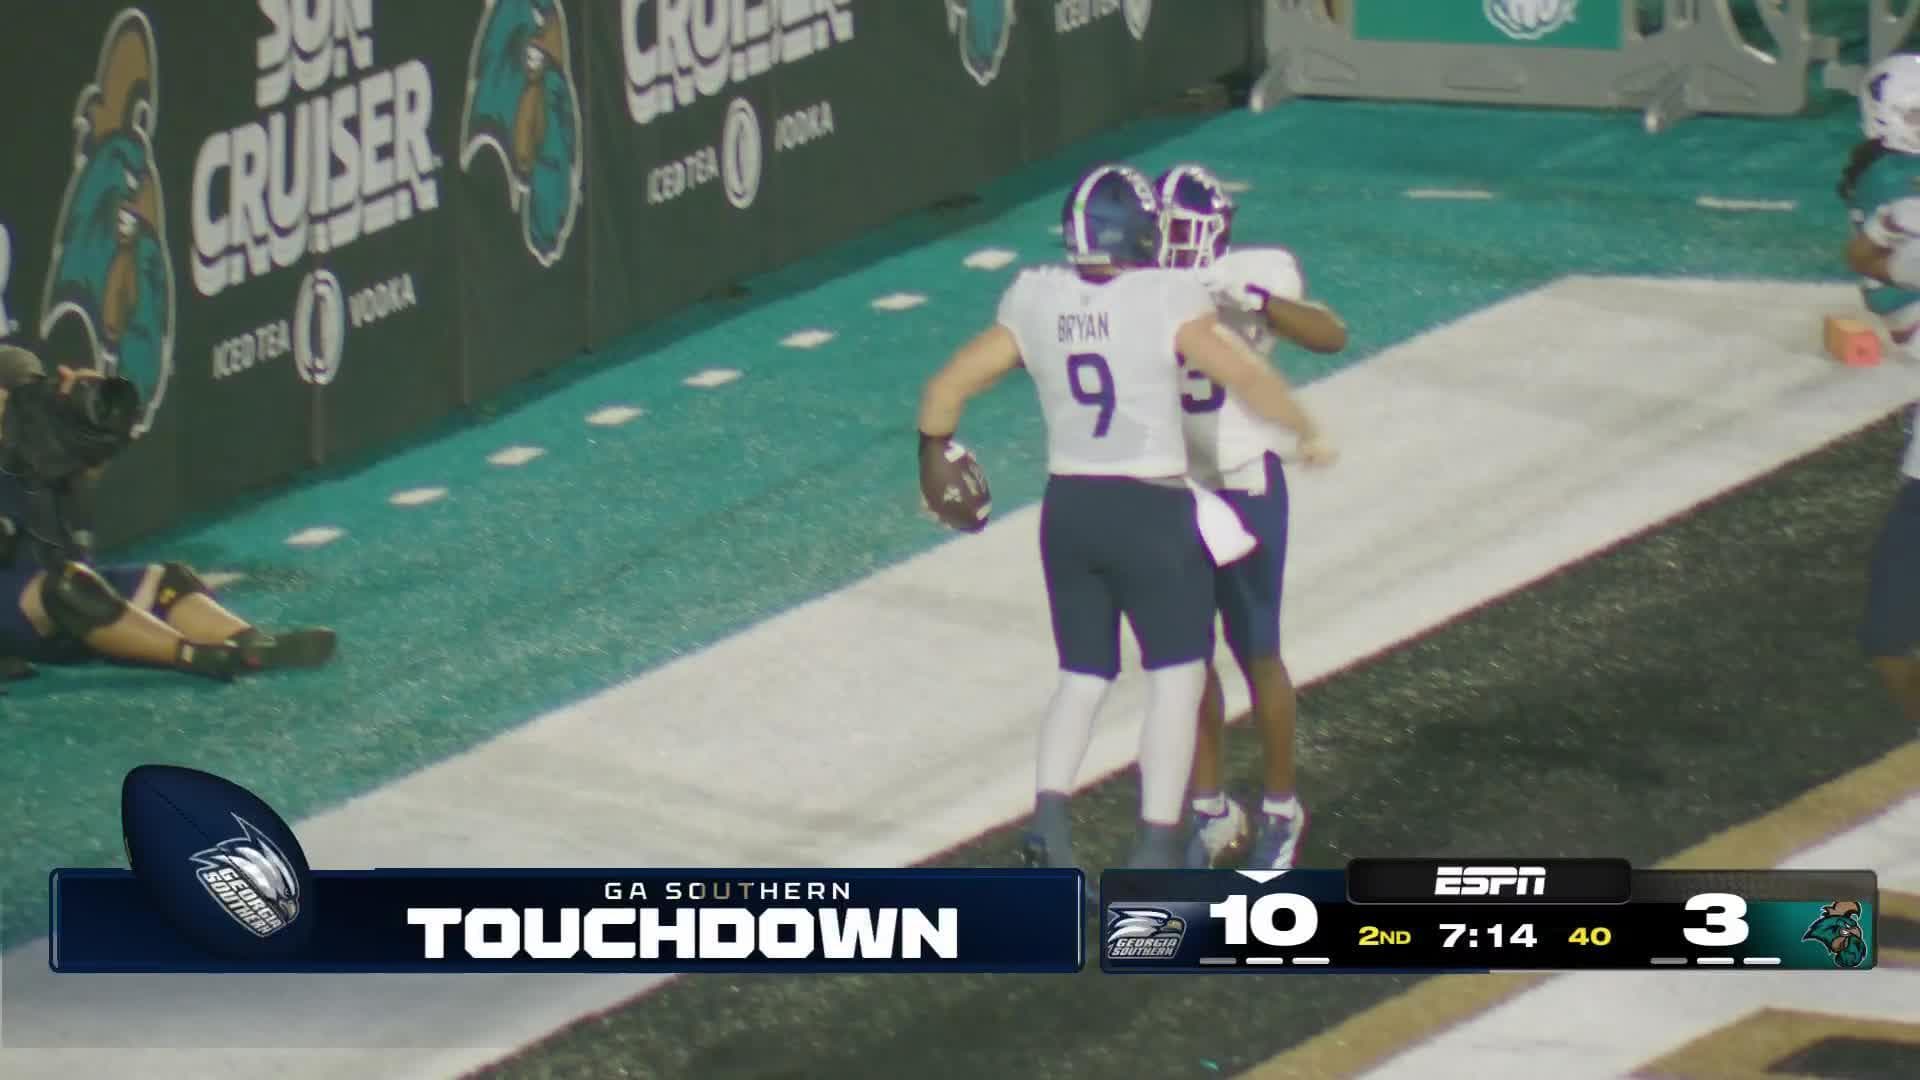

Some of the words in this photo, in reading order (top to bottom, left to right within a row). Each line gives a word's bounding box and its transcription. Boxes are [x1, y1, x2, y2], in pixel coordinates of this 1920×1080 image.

[191, 58, 440, 296] CRUISER
[684, 146, 719, 190] TEA
[255, 319, 290, 361] TEA
[1057, 312, 1110, 343] BRYAN
[1066, 352, 1116, 438] 9
